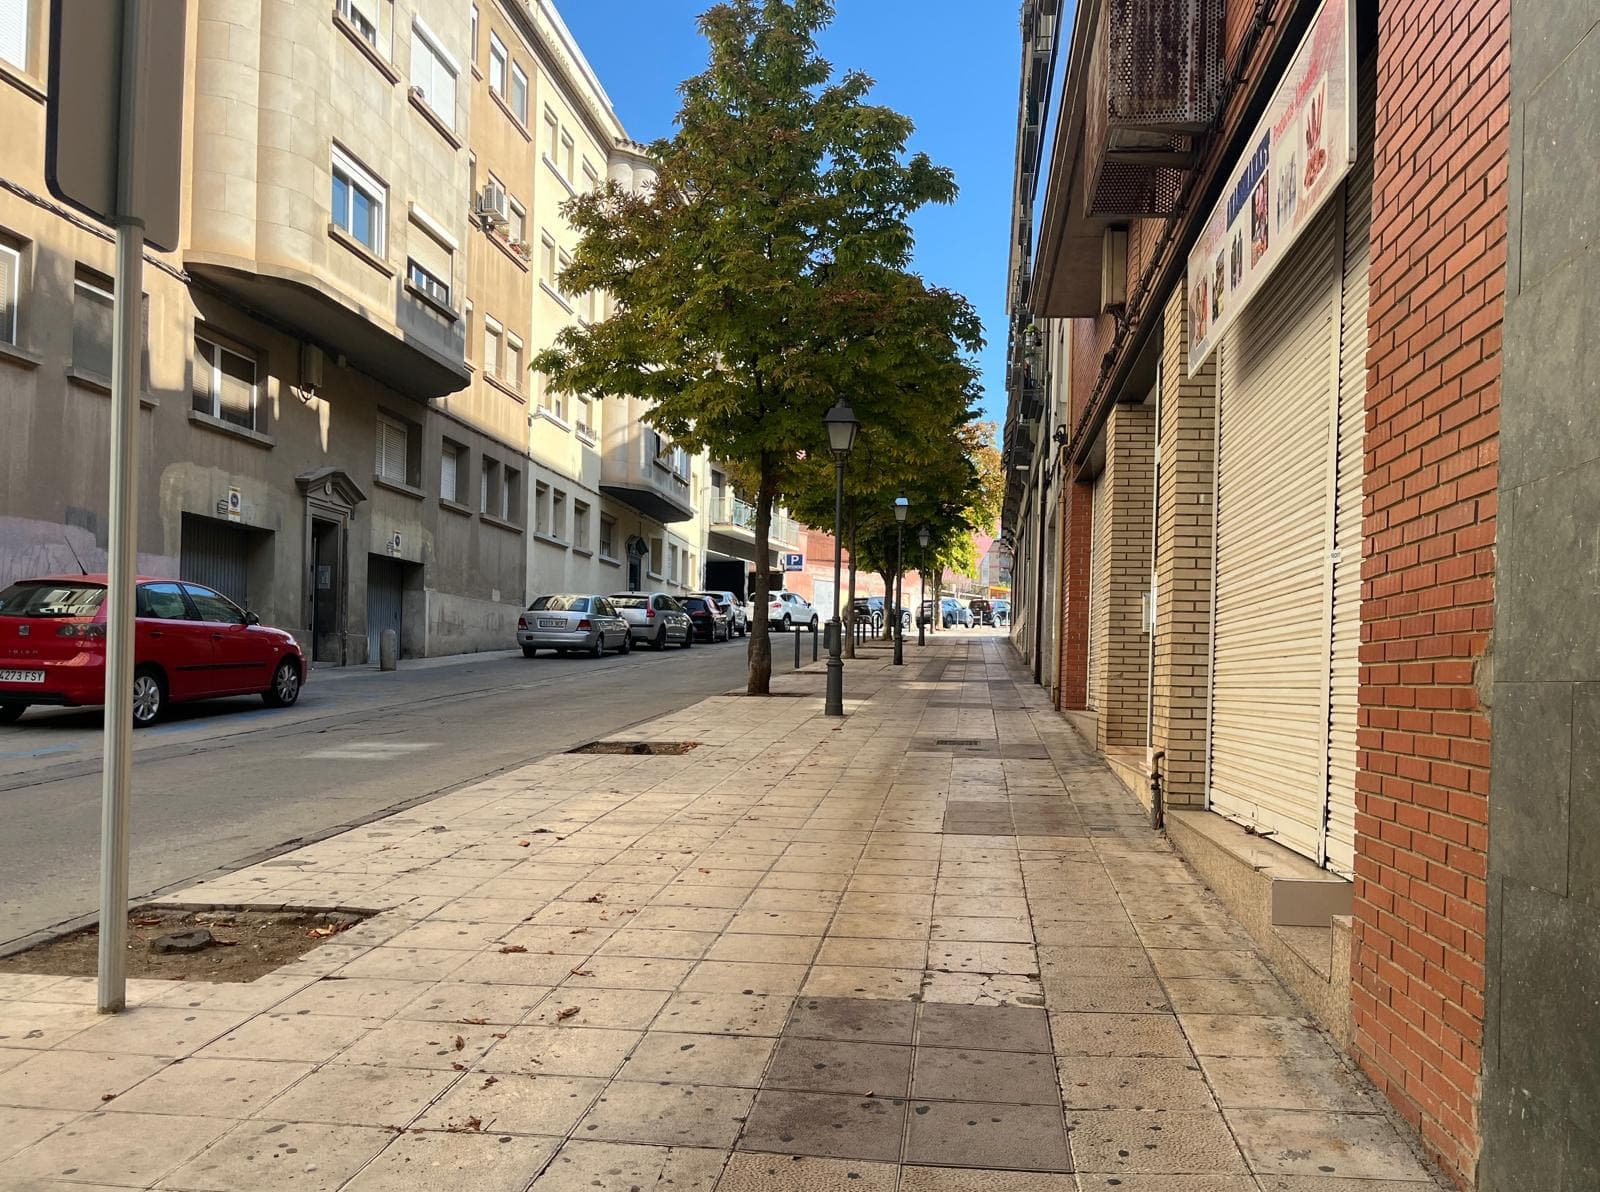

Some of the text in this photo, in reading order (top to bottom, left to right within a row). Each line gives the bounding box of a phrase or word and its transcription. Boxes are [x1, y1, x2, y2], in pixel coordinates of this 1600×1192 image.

[791, 555, 800, 565] P
[0, 670, 44, 681] 4273 FSY
